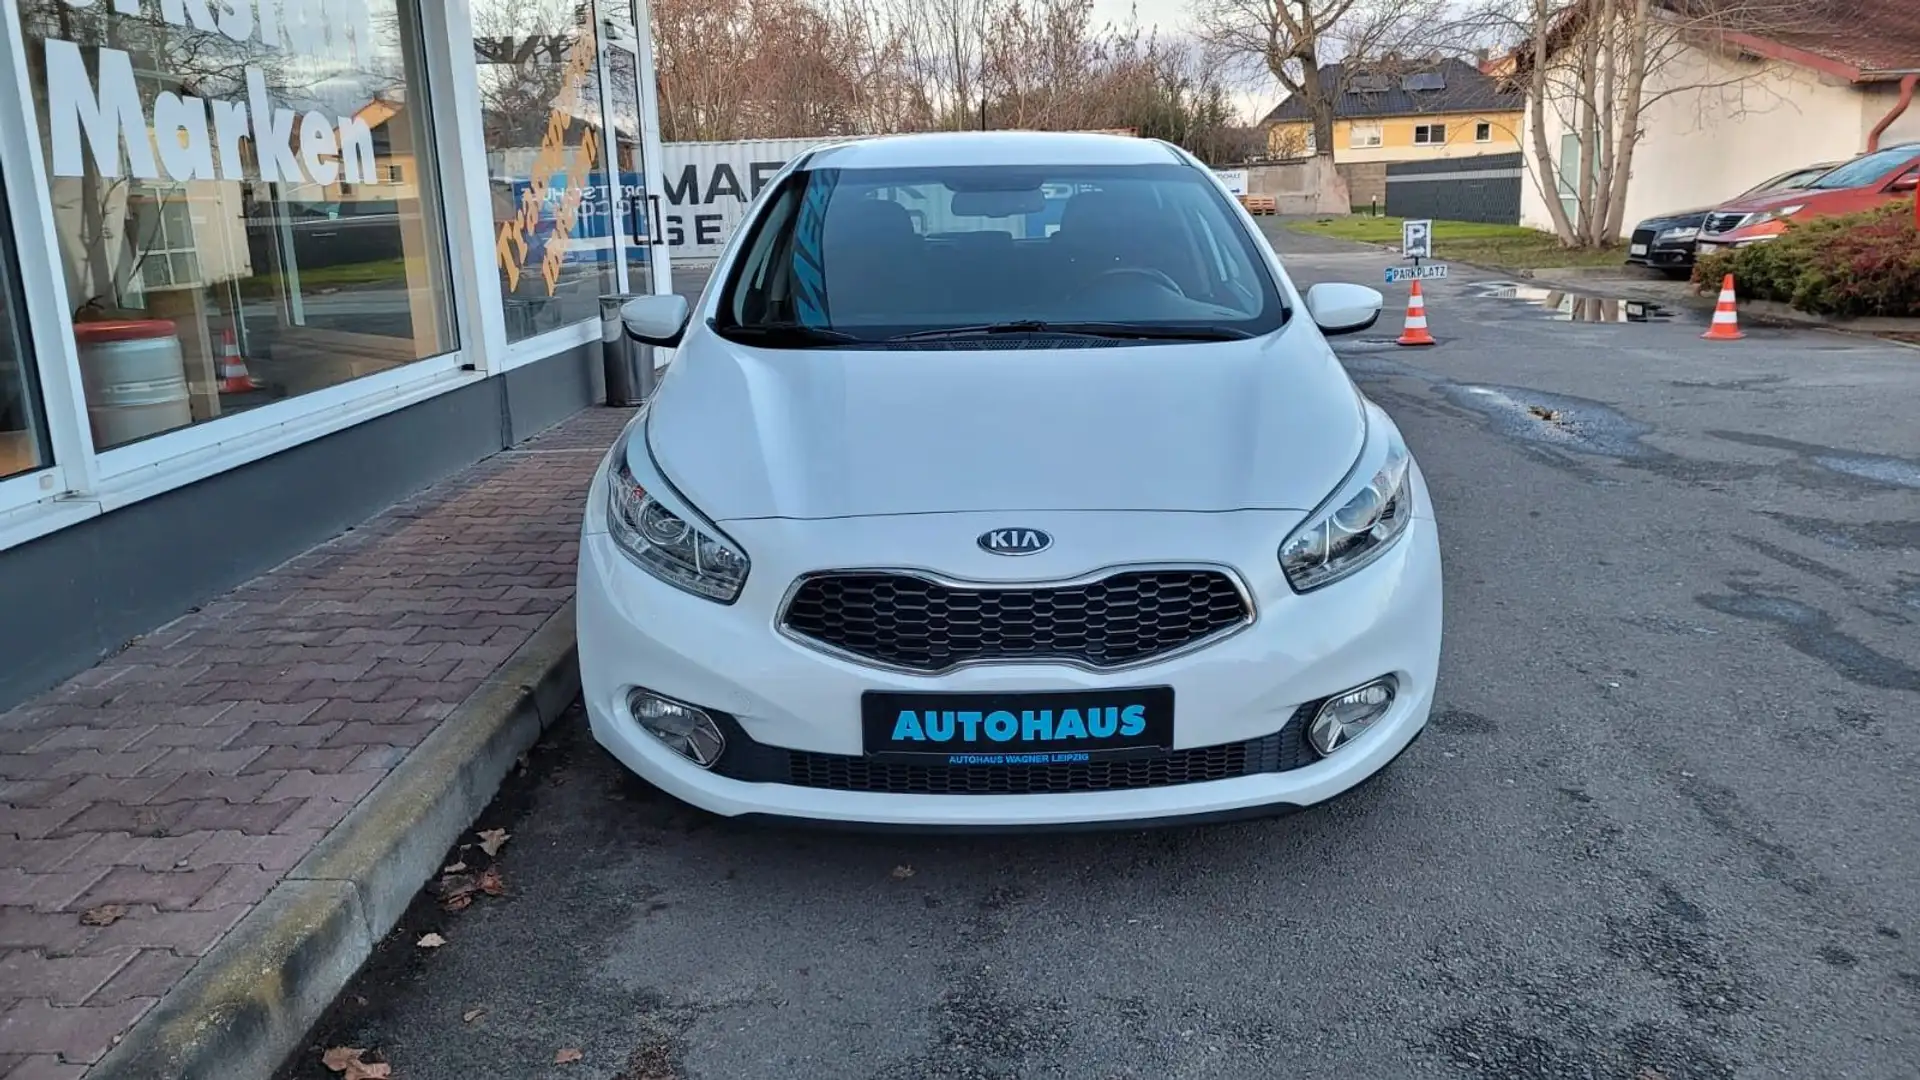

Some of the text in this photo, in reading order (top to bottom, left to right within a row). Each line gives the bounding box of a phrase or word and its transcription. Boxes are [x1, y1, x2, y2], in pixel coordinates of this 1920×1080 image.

[44, 37, 378, 186] Marken
[1407, 224, 1427, 248] P
[1394, 266, 1447, 280] PARKPLATZ
[990, 530, 1041, 549] KIA
[891, 704, 1146, 742] AUTOHAUS
[949, 752, 1090, 765] AUTOHAUS WAGNER LEIPZIG
